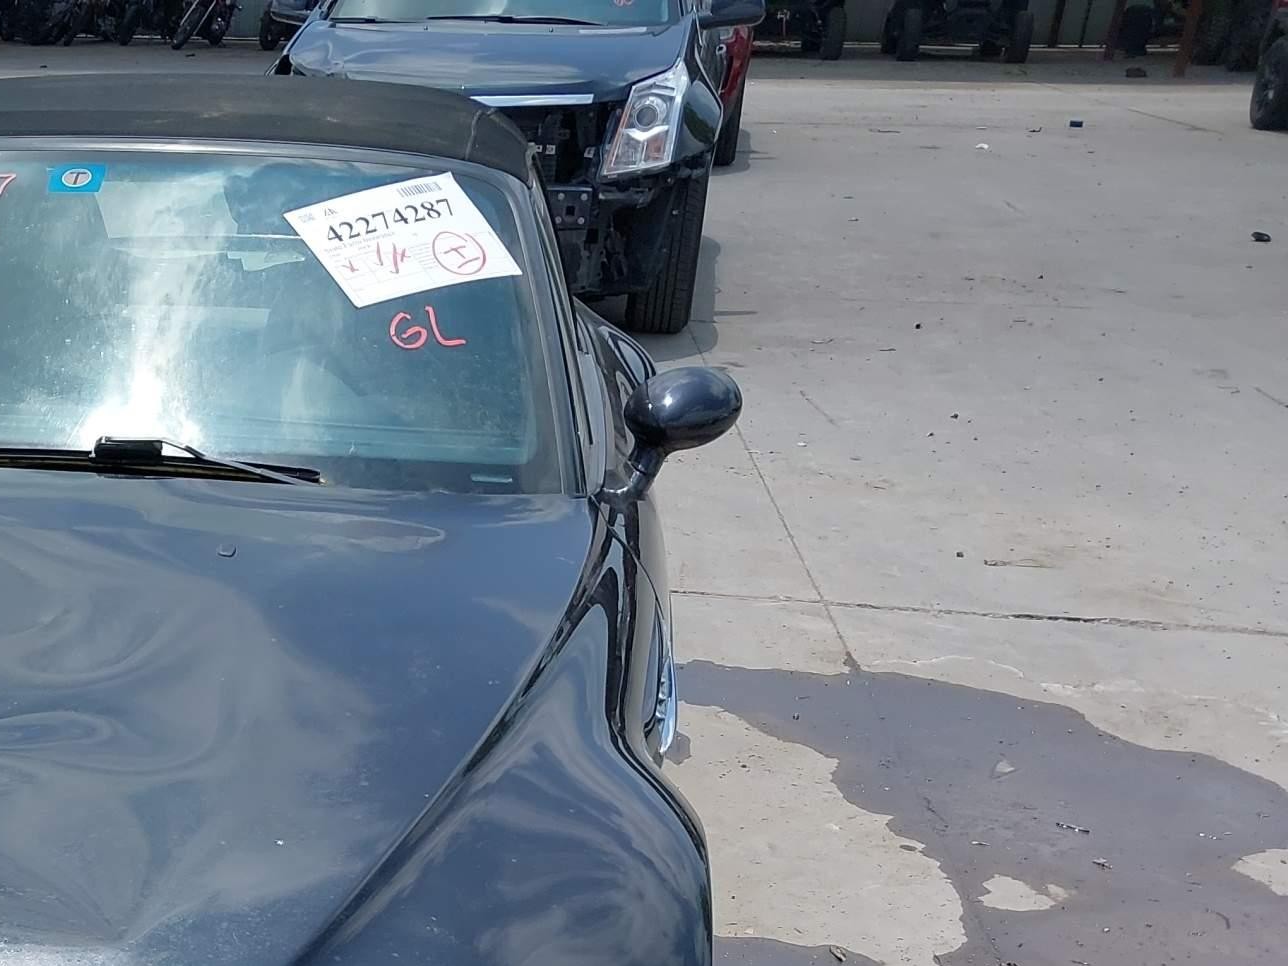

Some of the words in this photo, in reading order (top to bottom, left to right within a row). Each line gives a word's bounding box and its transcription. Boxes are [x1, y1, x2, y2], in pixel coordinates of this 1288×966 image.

[70, 171, 88, 185] T
[326, 198, 454, 243] 42274287
[389, 305, 467, 350] GL
